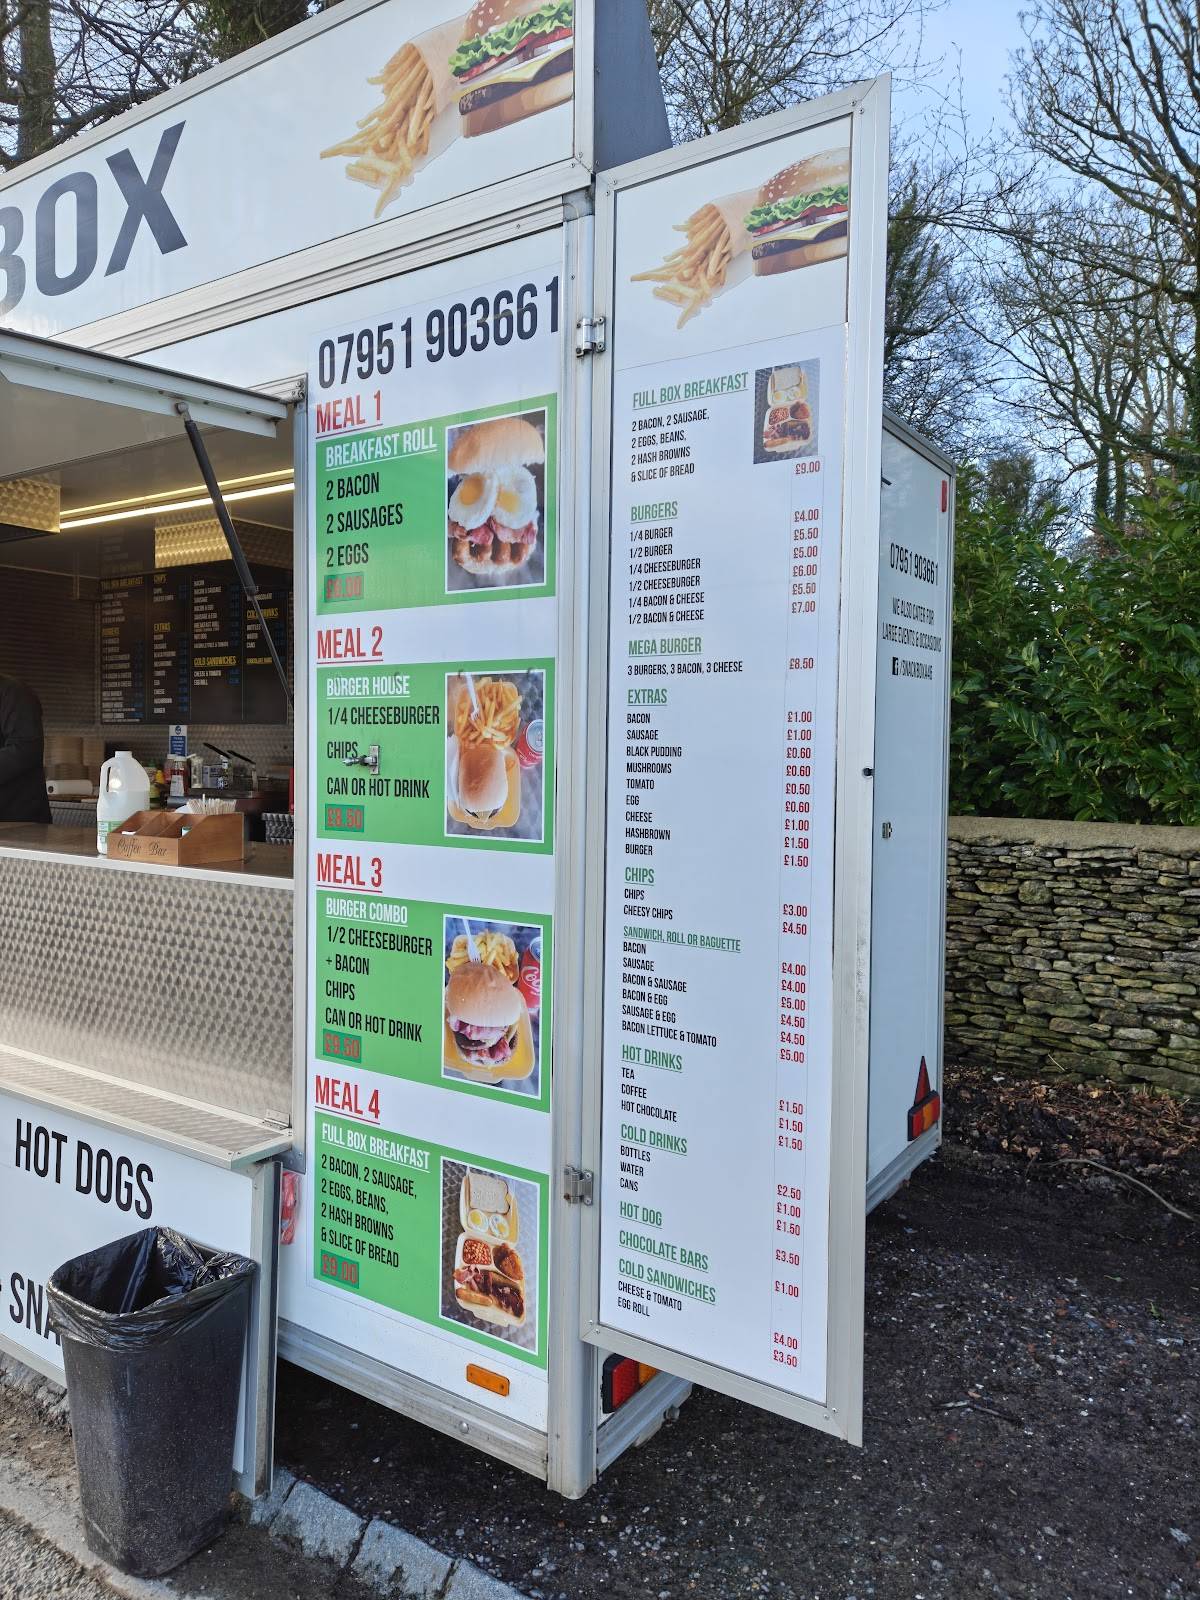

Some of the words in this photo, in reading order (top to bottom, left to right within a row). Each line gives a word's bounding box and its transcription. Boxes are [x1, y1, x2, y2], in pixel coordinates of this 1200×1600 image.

[319, 317, 412, 389] 07951
[426, 276, 558, 362] 903661
[633, 390, 658, 408] FULL
[660, 384, 681, 402] BOX
[684, 372, 748, 398] BREAKFAST
[316, 396, 365, 433] MEAL
[374, 390, 381, 420] 1
[326, 433, 400, 468] BREAKFAST
[403, 427, 437, 450] ROLL
[795, 461, 820, 475] £9.00
[327, 481, 333, 500] 2
[337, 472, 379, 498] BACON
[327, 514, 333, 534] 2
[337, 503, 403, 532] SAUSAGES
[631, 501, 678, 521] BURGERS
[794, 509, 819, 523] £4.00
[630, 530, 643, 542] 1/4
[645, 527, 673, 540] BURGER
[794, 528, 818, 540] £5.50
[327, 547, 333, 567] 2
[338, 543, 369, 566] EGGS
[630, 547, 642, 558] 1/2
[645, 544, 673, 557] BURGER
[793, 546, 818, 558] £5.00
[793, 565, 817, 577] £6.00
[891, 543, 912, 575] 07951
[915, 554, 938, 586] 903661
[792, 583, 816, 595] £5.50
[792, 601, 816, 614] £7.00
[893, 597, 900, 615] WE
[901, 599, 911, 618] ALSO
[913, 602, 925, 623] CATER
[317, 627, 366, 659] MEAL
[372, 626, 383, 657] 2
[883, 622, 897, 642] LARGE
[899, 626, 915, 647] EVENTS
[920, 633, 941, 652] OCCASIONS
[629, 640, 658, 655] MEGA
[660, 637, 702, 653] BURGER
[789, 658, 814, 670] £8.50
[327, 678, 369, 696] BURGER
[373, 676, 409, 695] HOUSE
[628, 689, 667, 704] EXTRAS
[329, 707, 347, 725] 1/4
[351, 706, 439, 725] CHEESEBURGER
[627, 714, 650, 724] BACON
[788, 711, 812, 722] £1.00
[627, 730, 658, 740] SAUSAGE
[787, 730, 811, 740] £1.00
[327, 741, 358, 759] CHIPS
[626, 746, 649, 757] BLACK
[651, 746, 681, 757] PUDDING
[786, 748, 811, 758] £0.60
[626, 763, 671, 774] MUSHROOMS
[786, 766, 811, 777] £0.60
[327, 778, 348, 795] CAN
[352, 779, 365, 795] OR
[369, 779, 391, 797] HOT
[394, 779, 429, 798] DRINK
[626, 779, 654, 790] TOMATO
[786, 784, 810, 794] £0.50
[626, 795, 639, 806] EGG
[785, 801, 809, 812] £0.60
[626, 812, 652, 822] CHEESE
[785, 819, 809, 831] £1.00
[625, 828, 670, 840] HASHBROWN
[118, 838, 141, 857] Coffee
[149, 841, 167, 857] Bar
[625, 844, 653, 855] BURGER
[784, 837, 809, 849] £1.50
[784, 855, 808, 867] £1.50
[317, 854, 365, 886] MEAL
[371, 857, 382, 887] 3
[625, 867, 654, 883] CHIPS
[624, 888, 644, 900] CHIPS
[326, 898, 367, 919] BURGER
[370, 904, 407, 923] COMBO
[624, 905, 650, 918] CHEESY
[652, 907, 673, 920] CHIPS
[783, 904, 807, 917] £3.00
[782, 922, 807, 935] £4.50
[328, 926, 347, 944] 1/2
[349, 928, 432, 956] CHEESEBURGER
[624, 926, 664, 943] SANDWICH,
[667, 931, 685, 945] ROLL
[688, 934, 698, 946] OR
[700, 935, 741, 951] BAGUETTE
[624, 942, 646, 954] BACON
[335, 954, 369, 975] BACON
[623, 958, 654, 972] SAUSAGE
[782, 963, 806, 976] £4.00
[326, 979, 355, 1000] CHIPS
[782, 980, 806, 993] £4.00
[781, 997, 805, 1011] £5.00
[781, 1015, 805, 1028] £4.50
[780, 1032, 805, 1045] £4.50
[622, 1045, 641, 1062] HOT
[645, 1048, 682, 1070] DRINKS
[780, 1049, 804, 1063] £5.00
[622, 1067, 634, 1079] TEA
[315, 1075, 363, 1115] MEAL
[368, 1090, 380, 1119] 4
[622, 1084, 647, 1098] COFFEE
[621, 1100, 634, 1113] HOT
[636, 1102, 677, 1122] CHOCOLATE
[779, 1100, 803, 1115] £1.50
[779, 1118, 803, 1133] £1.50
[621, 1123, 646, 1143] COLD
[650, 1130, 687, 1153] DRINKS
[779, 1136, 802, 1151] £1.50
[322, 1123, 344, 1145] FULL
[347, 1131, 367, 1153] BOX
[369, 1136, 430, 1170] BREAKFAST
[621, 1146, 650, 1162] BOTTLES
[16, 1119, 67, 1184] HOT
[76, 1141, 153, 1220] DOGS
[621, 1161, 644, 1176] WATER
[620, 1177, 638, 1191] CANS
[777, 1185, 801, 1200] £2.50
[620, 1201, 639, 1219] HOT
[642, 1207, 662, 1226] DOG
[777, 1202, 800, 1218] £1.00
[322, 1203, 327, 1217] 2
[329, 1205, 353, 1226] HASH
[355, 1213, 393, 1240] BROWNS
[776, 1220, 800, 1236] £1.50
[620, 1230, 677, 1261] CHOCOLATE
[680, 1249, 708, 1270] BARS
[776, 1250, 800, 1265] £3.50
[619, 1258, 644, 1279] COLD
[647, 1267, 716, 1302] SANDWICHES
[775, 1281, 799, 1297] £1.00
[618, 1297, 631, 1310] EGG
[633, 1301, 650, 1317] ROLL
[774, 1333, 798, 1350] £4.00
[774, 1350, 797, 1368] £3.50
